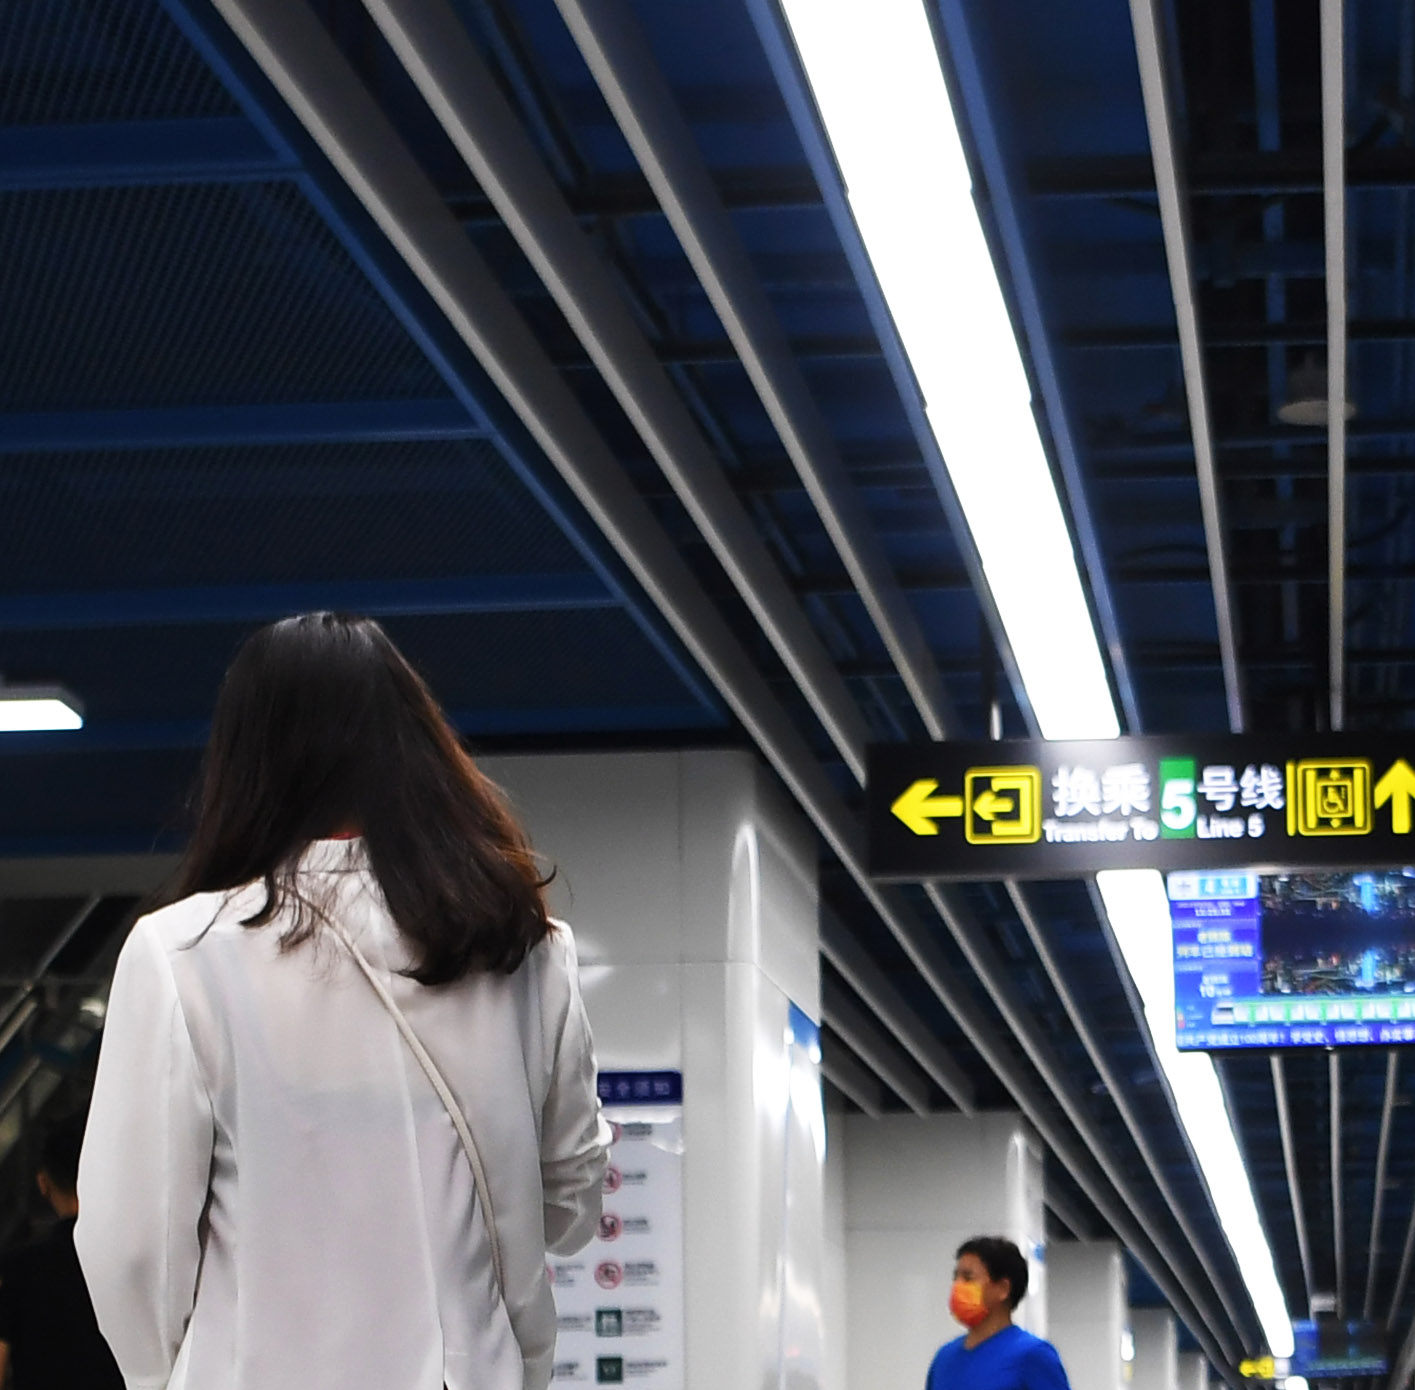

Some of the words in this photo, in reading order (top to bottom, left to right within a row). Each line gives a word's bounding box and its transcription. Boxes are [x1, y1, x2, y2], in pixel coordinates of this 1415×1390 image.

[1042, 818, 1129, 842] Transfer
[1130, 816, 1159, 840] To
[1197, 814, 1245, 838] Line
[1248, 812, 1265, 838] 5
